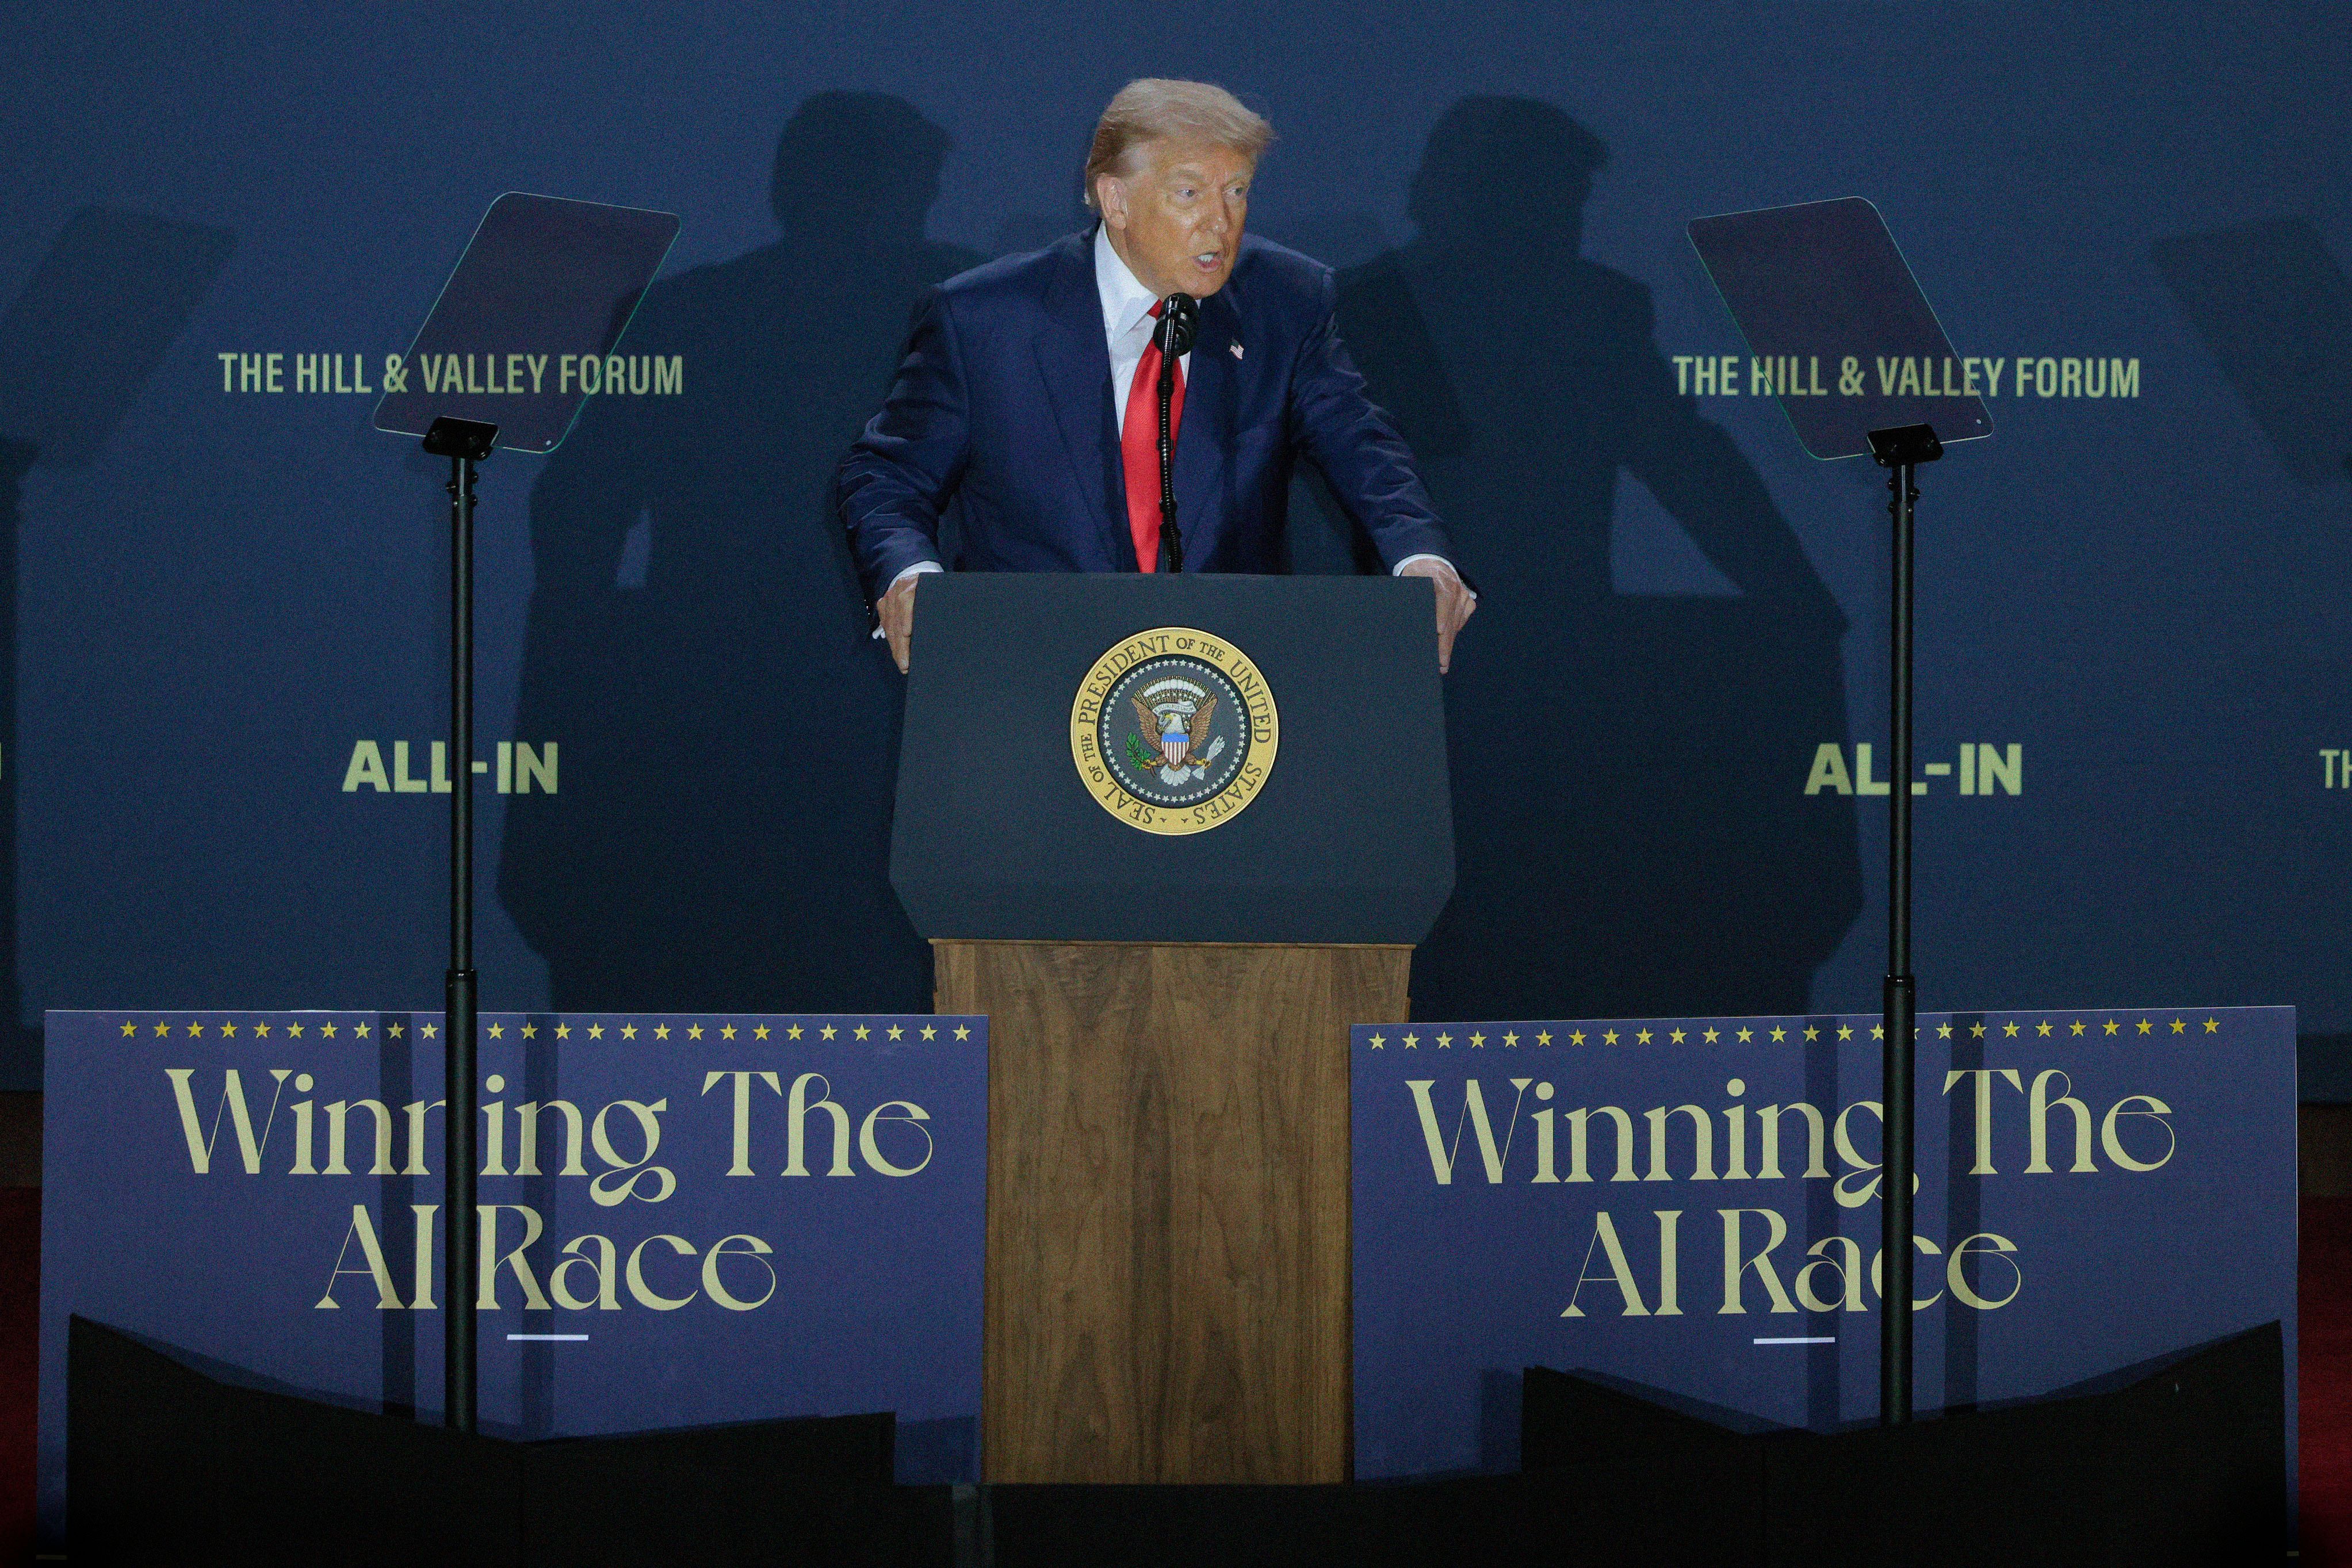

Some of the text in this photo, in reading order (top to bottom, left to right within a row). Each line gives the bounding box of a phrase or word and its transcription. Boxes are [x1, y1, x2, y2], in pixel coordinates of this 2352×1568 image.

[218, 353, 683, 396] THE HILL & VALLEY FORUM
[1672, 355, 2140, 399] THE HILL & VALLEY FORUM
[342, 740, 559, 794] ALL-IN
[1078, 634, 1272, 825] SEAL OF THE PRESIDENT OF THE UNITED STATES
[1804, 743, 2022, 796] AL-IN
[701, 1071, 933, 1177] The
[1405, 1069, 2175, 1208] Winning The
[315, 1204, 777, 1311] AI Race
[1560, 1210, 1683, 1317] AI
